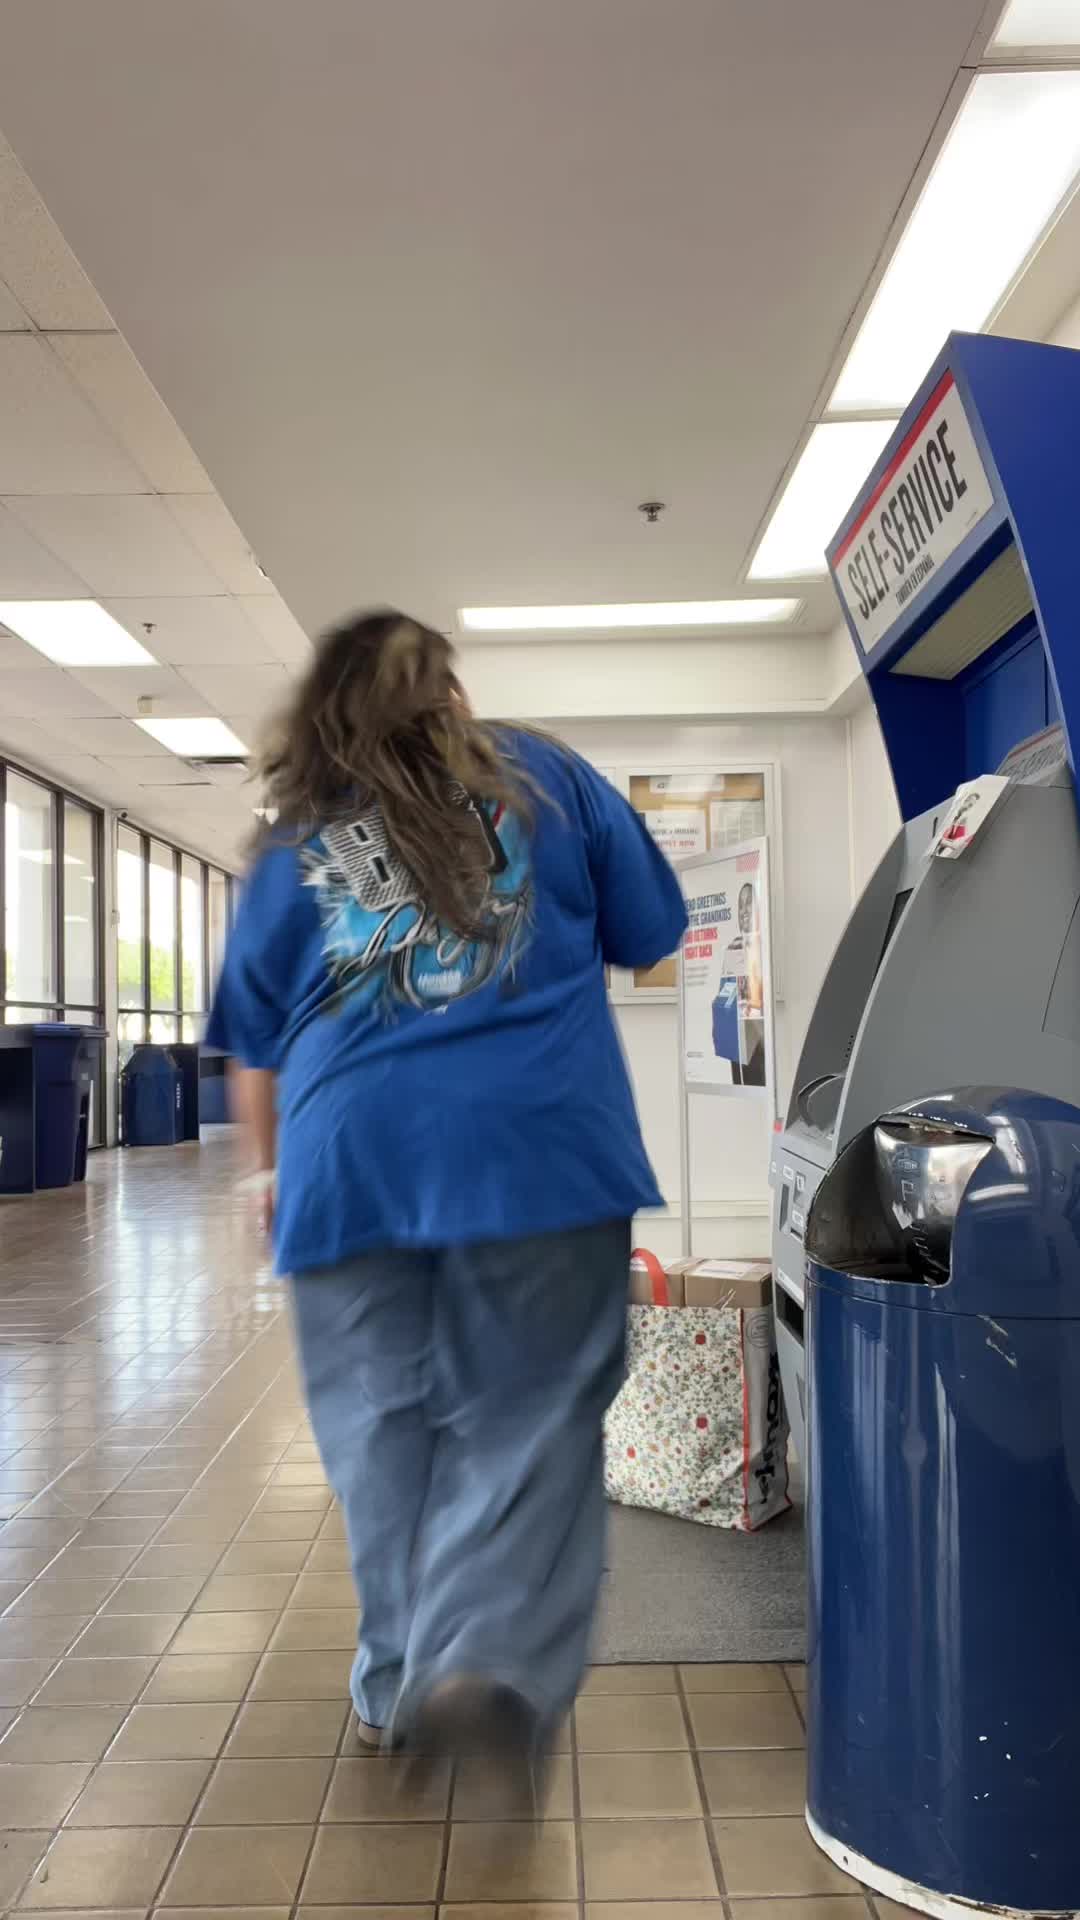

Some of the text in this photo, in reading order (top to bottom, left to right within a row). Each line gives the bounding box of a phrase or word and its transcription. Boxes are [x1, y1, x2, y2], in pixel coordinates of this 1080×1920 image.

[847, 419, 967, 621] SELF-SERVICE
[697, 892, 726, 910] GREETINGS
[700, 907, 731, 925] GRANDKIDS
